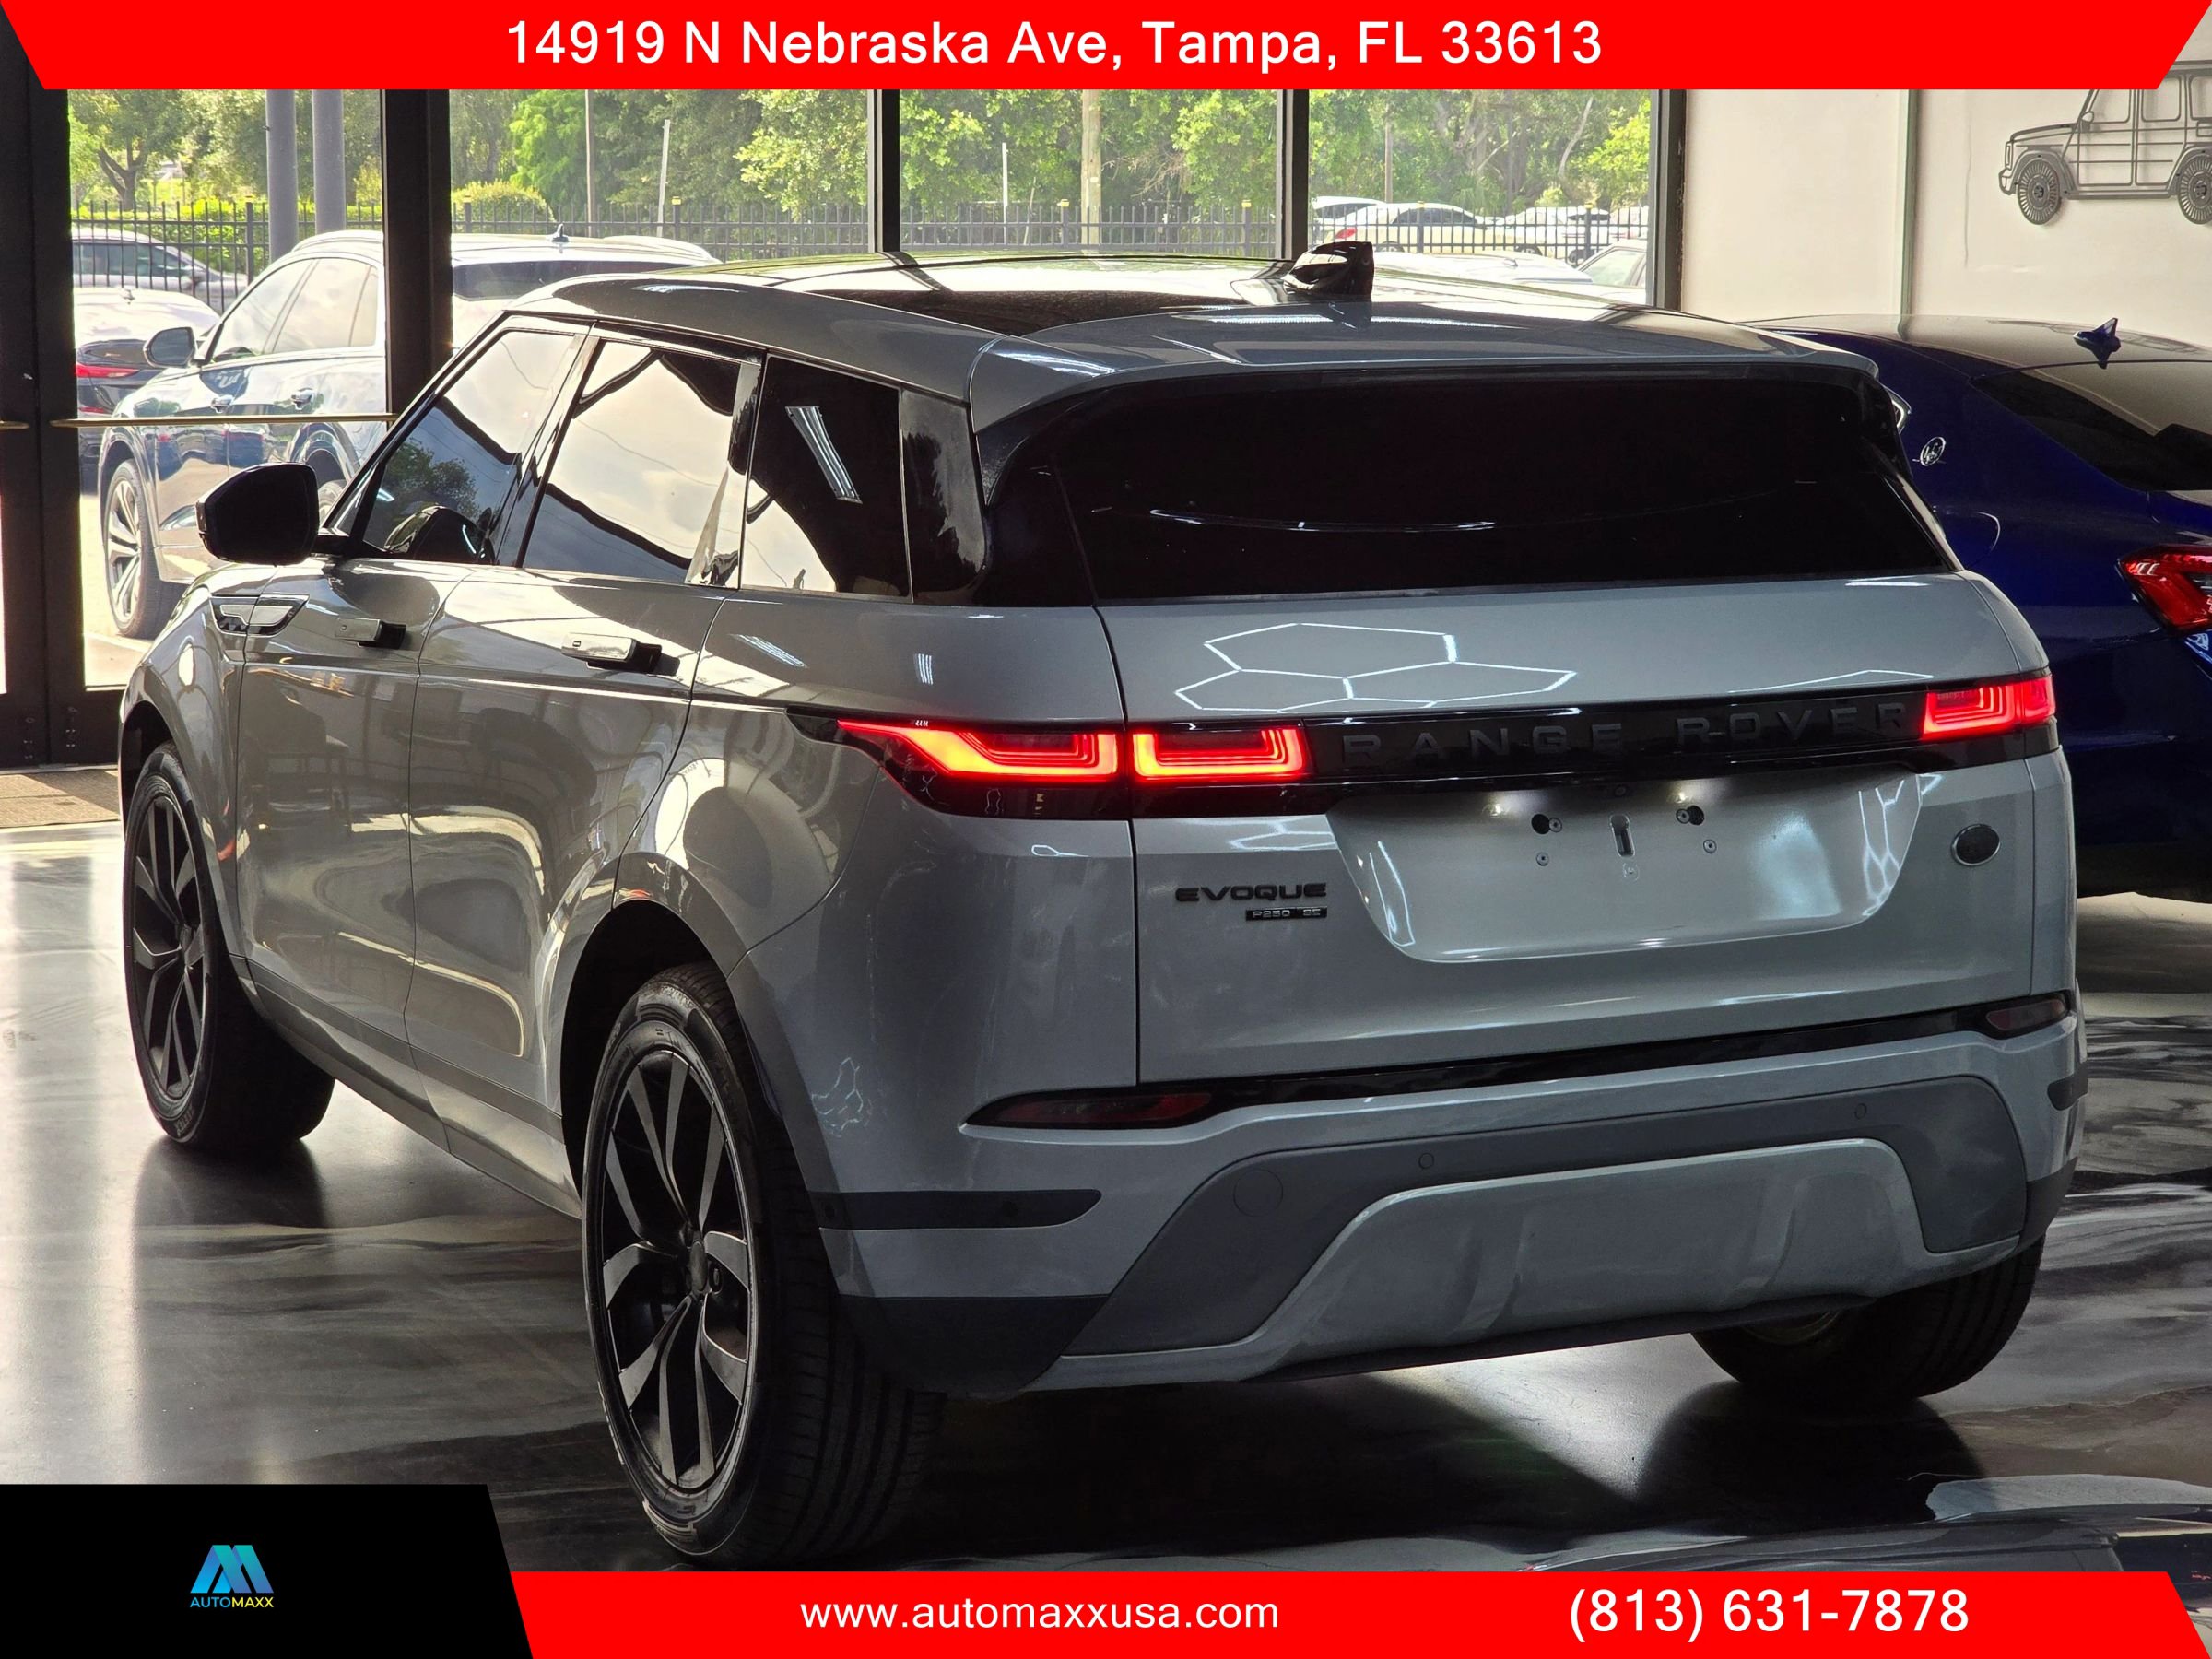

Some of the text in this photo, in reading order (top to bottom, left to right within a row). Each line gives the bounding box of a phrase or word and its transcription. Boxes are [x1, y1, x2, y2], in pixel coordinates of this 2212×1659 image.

[1341, 701, 1908, 763] RANGE ROVER
[1175, 882, 1327, 902] EVOQUE
[1253, 909, 1291, 919] P250
